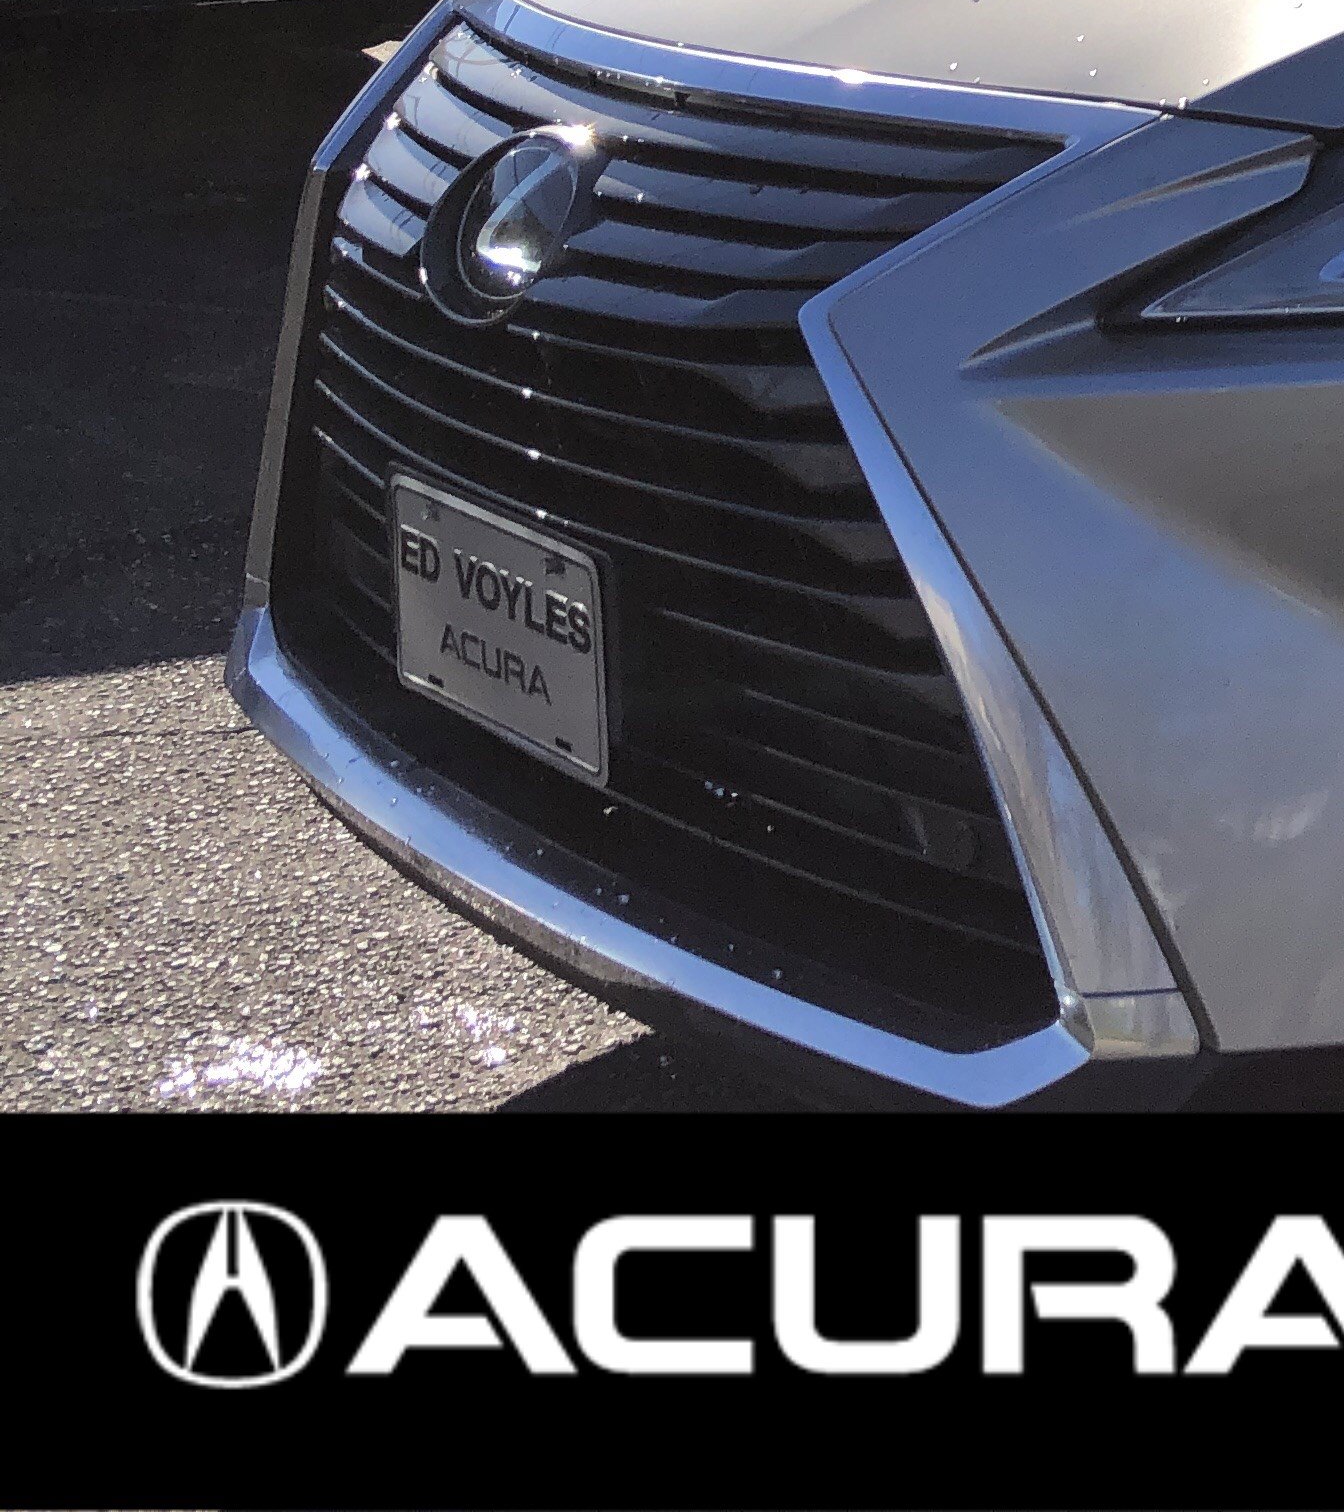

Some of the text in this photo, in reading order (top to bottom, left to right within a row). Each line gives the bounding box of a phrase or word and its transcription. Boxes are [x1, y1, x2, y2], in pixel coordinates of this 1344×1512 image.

[400, 523, 592, 655] ED VOYLES
[440, 623, 552, 706] ACURA
